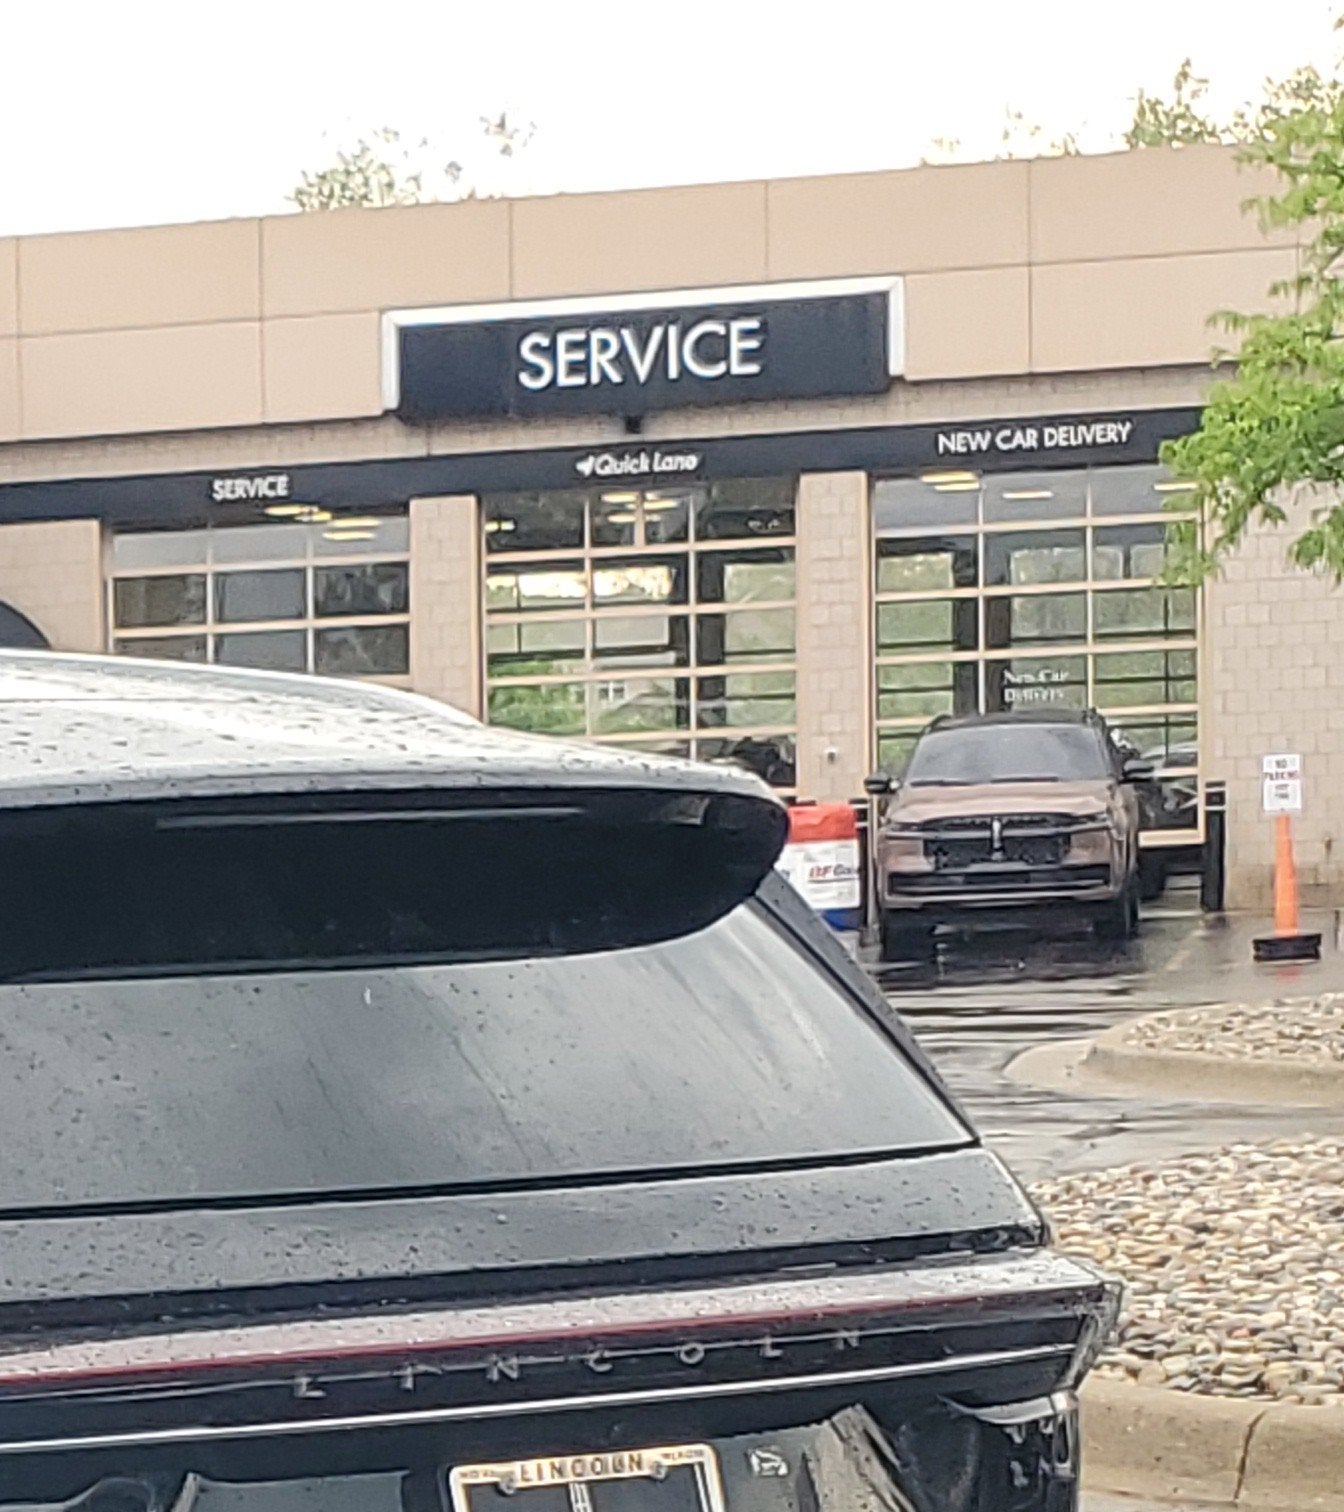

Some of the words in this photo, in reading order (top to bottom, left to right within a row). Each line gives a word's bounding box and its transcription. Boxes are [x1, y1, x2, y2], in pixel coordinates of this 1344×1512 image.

[517, 318, 762, 391] SERVICE
[937, 429, 992, 455] NEW
[994, 427, 1039, 451] CAR
[1043, 420, 1132, 448] DELIVERY
[594, 451, 651, 476] Quick
[653, 452, 700, 473] Lane
[212, 474, 289, 501] SERVICE
[293, 1327, 861, 1399] LINCOLN
